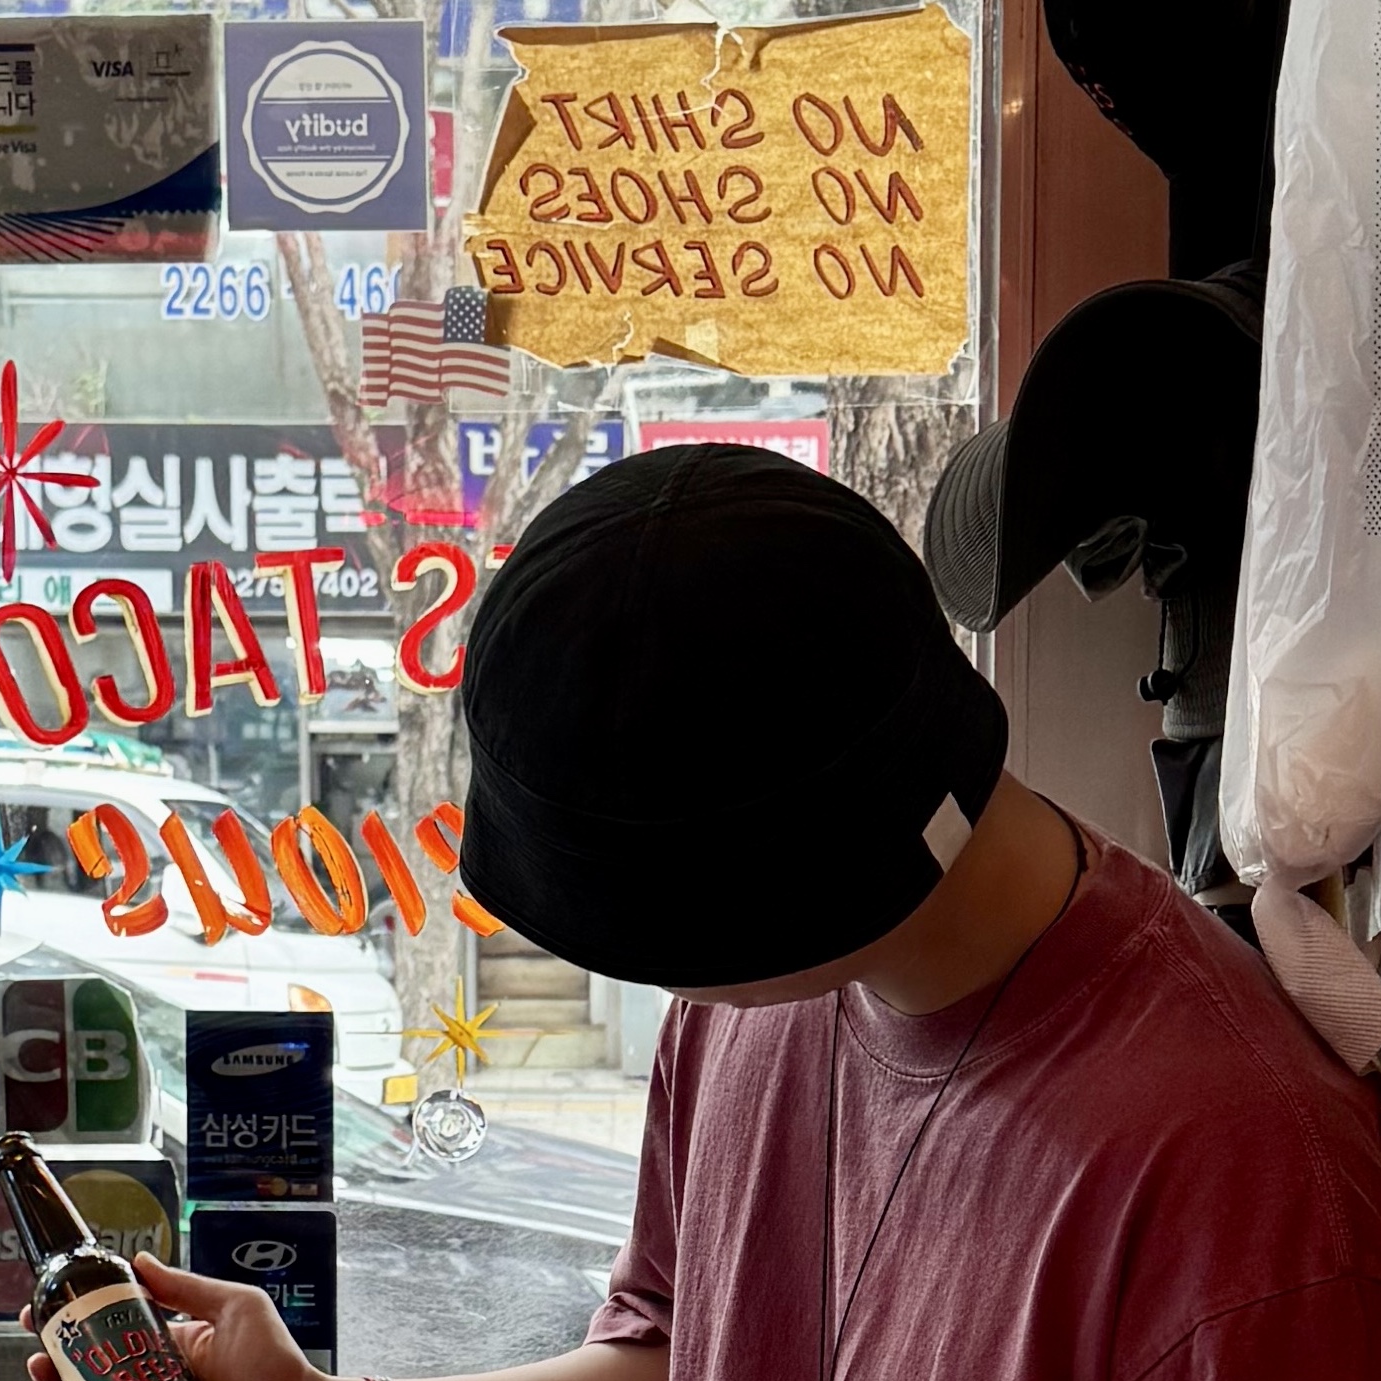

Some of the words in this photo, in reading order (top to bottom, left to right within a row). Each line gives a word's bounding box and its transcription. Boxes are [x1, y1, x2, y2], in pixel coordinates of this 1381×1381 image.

[91, 60, 135, 78] VISA
[11, 140, 38, 154] Visa
[165, 265, 270, 316] 2266
[200, 1112, 319, 1150] 삼성카드
